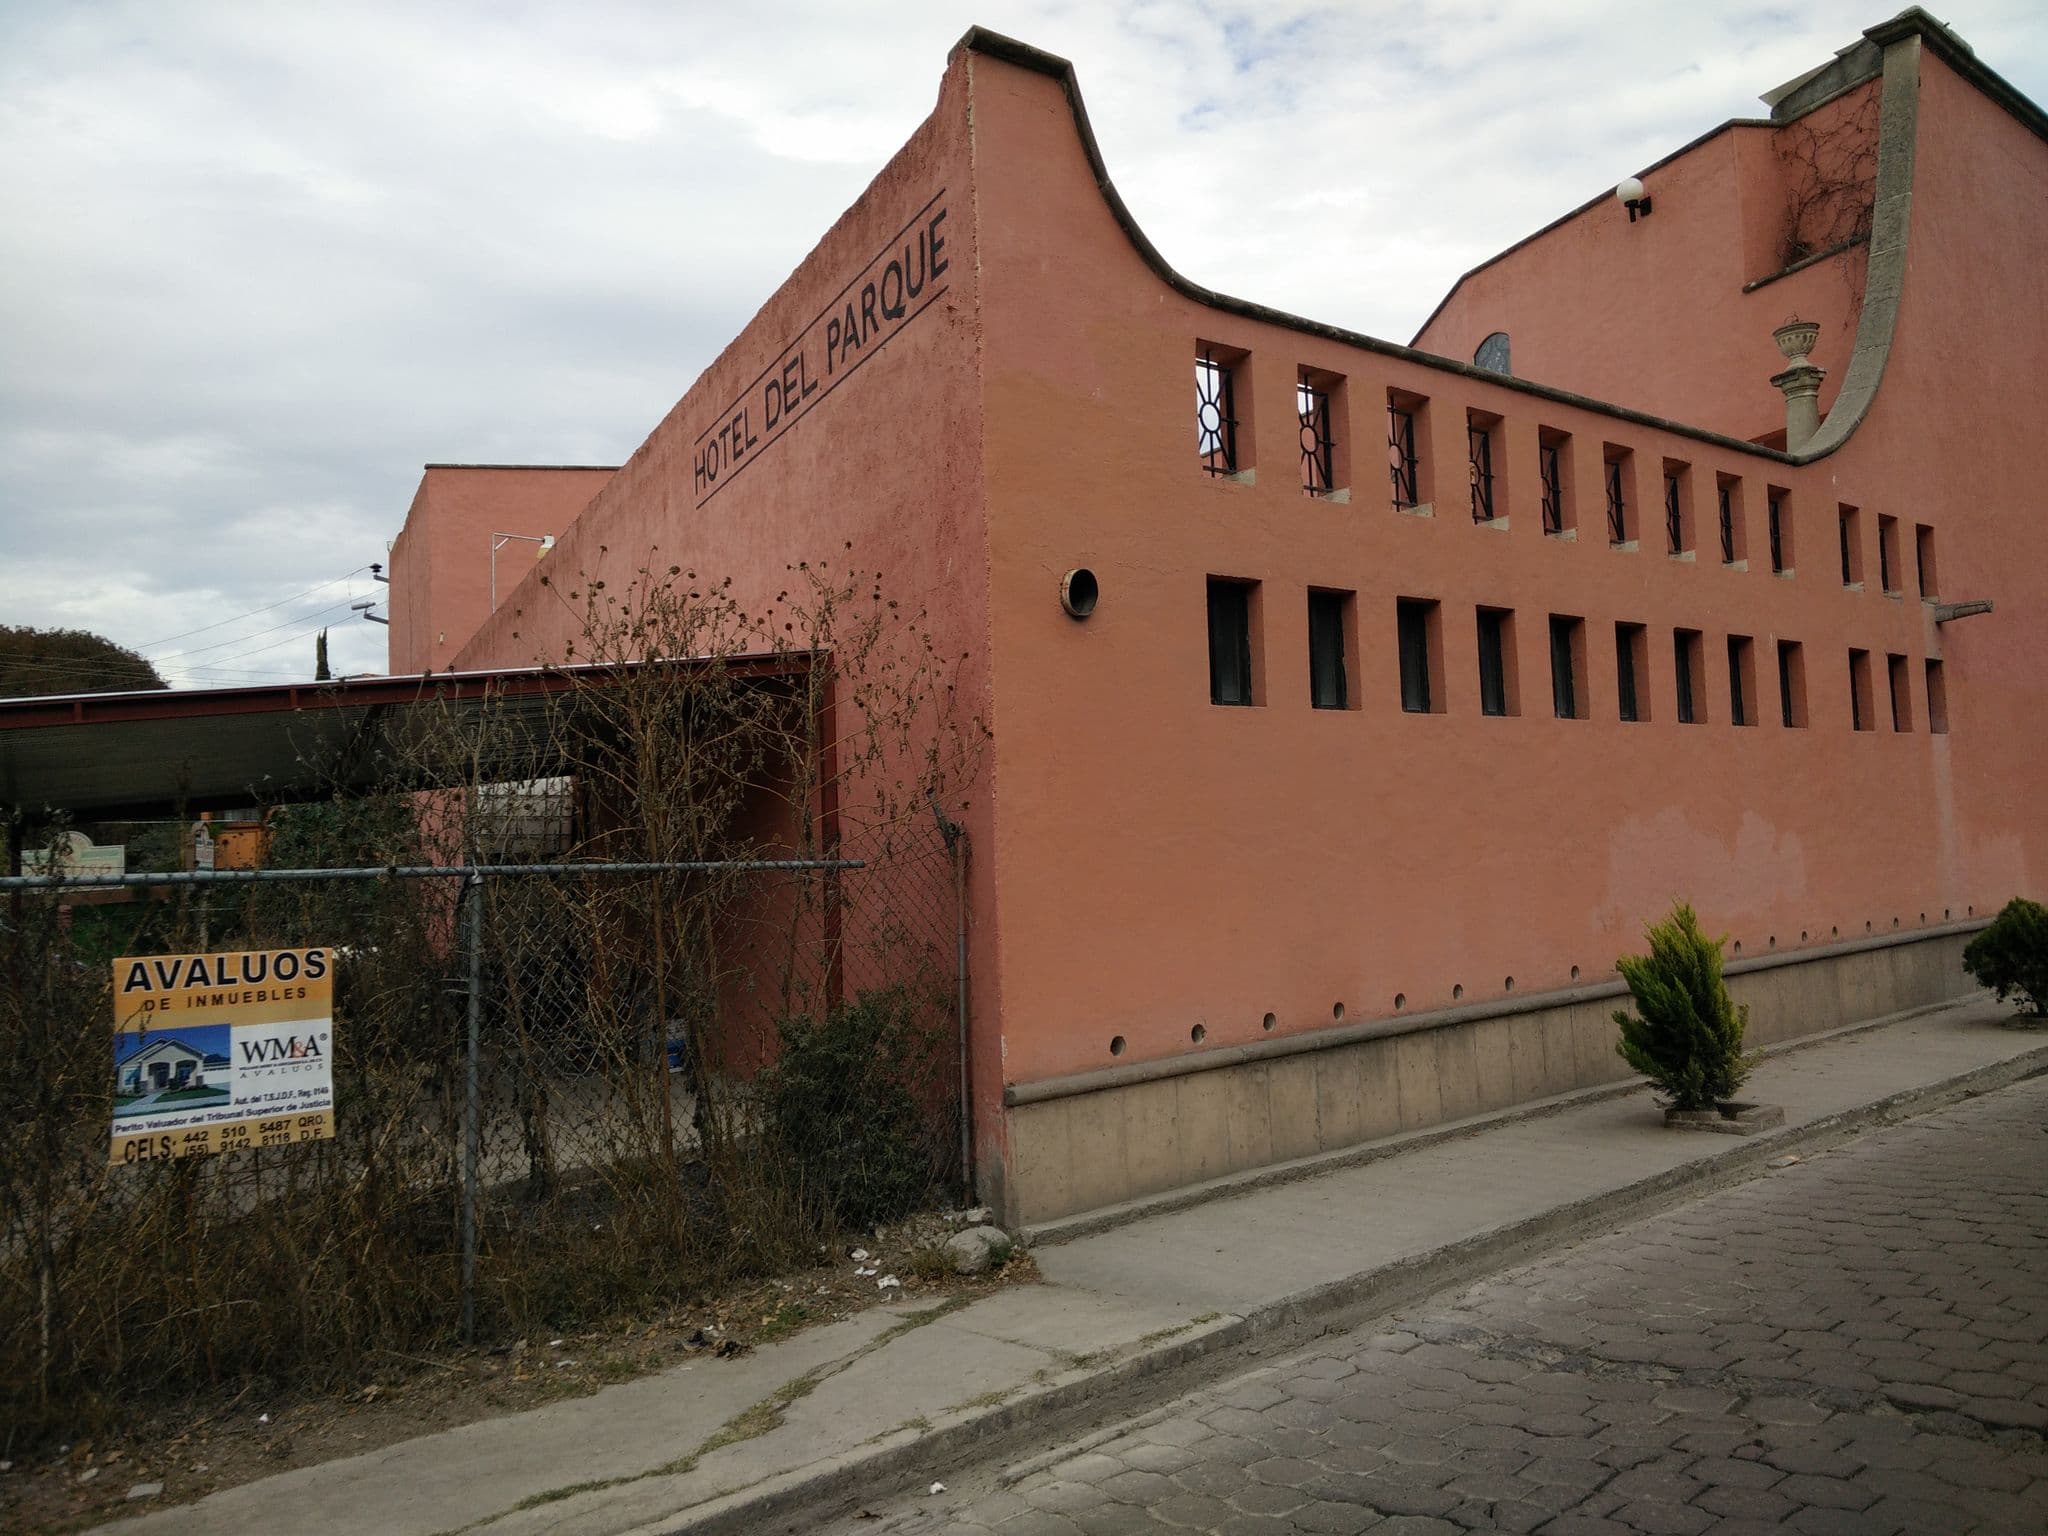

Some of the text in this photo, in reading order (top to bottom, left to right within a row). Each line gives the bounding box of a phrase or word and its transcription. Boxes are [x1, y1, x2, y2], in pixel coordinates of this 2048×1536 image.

[694, 208, 949, 495] HOTEL DEL PARQUE
[123, 950, 326, 993] AVALUOS
[143, 987, 307, 1012] DE INMUEBLES
[239, 1063, 324, 1079] AVALUOS
[115, 1099, 331, 1133] Perito Valuador del Tribunal Superior de Justicia
[183, 1115, 326, 1144] 442 510 5487 QRO.
[123, 1135, 177, 1164] CELS:
[183, 1143, 210, 1157] (55)
[220, 1138, 251, 1152] 9142
[300, 1128, 325, 1141] D.F.
